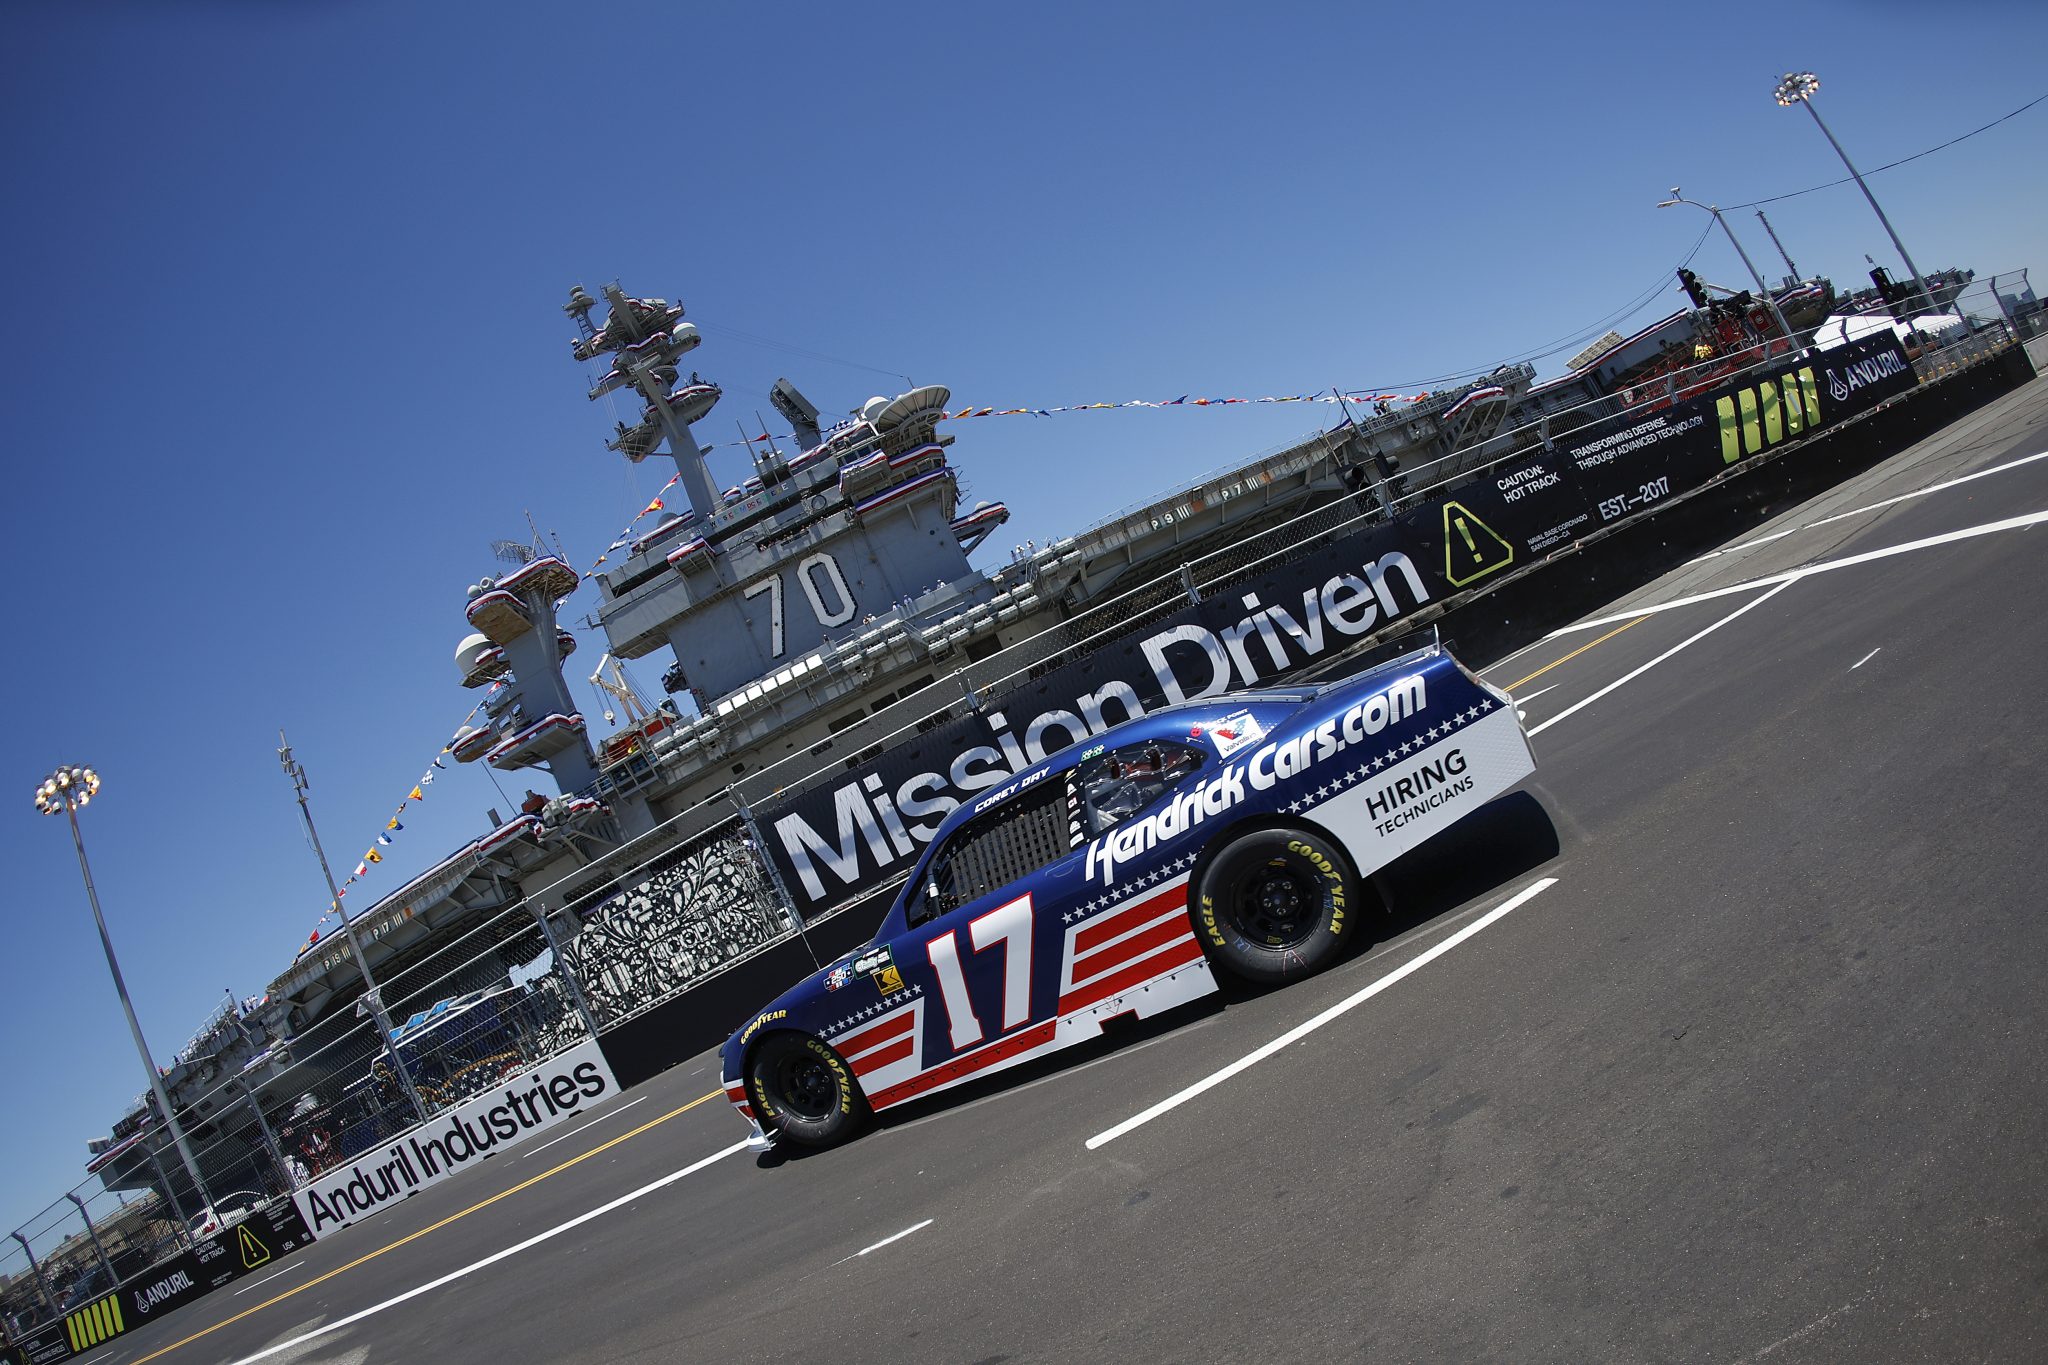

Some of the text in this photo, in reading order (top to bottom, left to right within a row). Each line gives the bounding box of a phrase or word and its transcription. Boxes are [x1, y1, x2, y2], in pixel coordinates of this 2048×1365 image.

[1846, 350, 1907, 392] ANDURIL
[1576, 415, 1704, 470] THROUGH ADVANCED TECHNOLOGY
[1632, 417, 1667, 436] DEFENSE
[1497, 464, 1545, 490] CAUTION:
[1503, 471, 1561, 504] HOT TRACK
[1527, 513, 1588, 546] NAVAL BASE CORONADO
[1530, 543, 1543, 553] SAN
[743, 552, 860, 659] 70
[774, 551, 1431, 901] Mission Driven
[974, 766, 1051, 813] COREY DAY
[1365, 749, 1467, 821] HIRING
[1375, 775, 1474, 838] TECHNICIANS
[1202, 894, 1226, 947] EAGLE
[926, 891, 1035, 1052] 17
[740, 1009, 787, 1045] GOODYEAR
[754, 1077, 776, 1117] EAGLE
[806, 1040, 851, 1114] GOODYEAR
[307, 1061, 606, 1232] Anduril Industries
[200, 1245, 227, 1264] HOT TRACK
[282, 1240, 296, 1251] USA
[148, 1270, 194, 1306] ANDURIL
